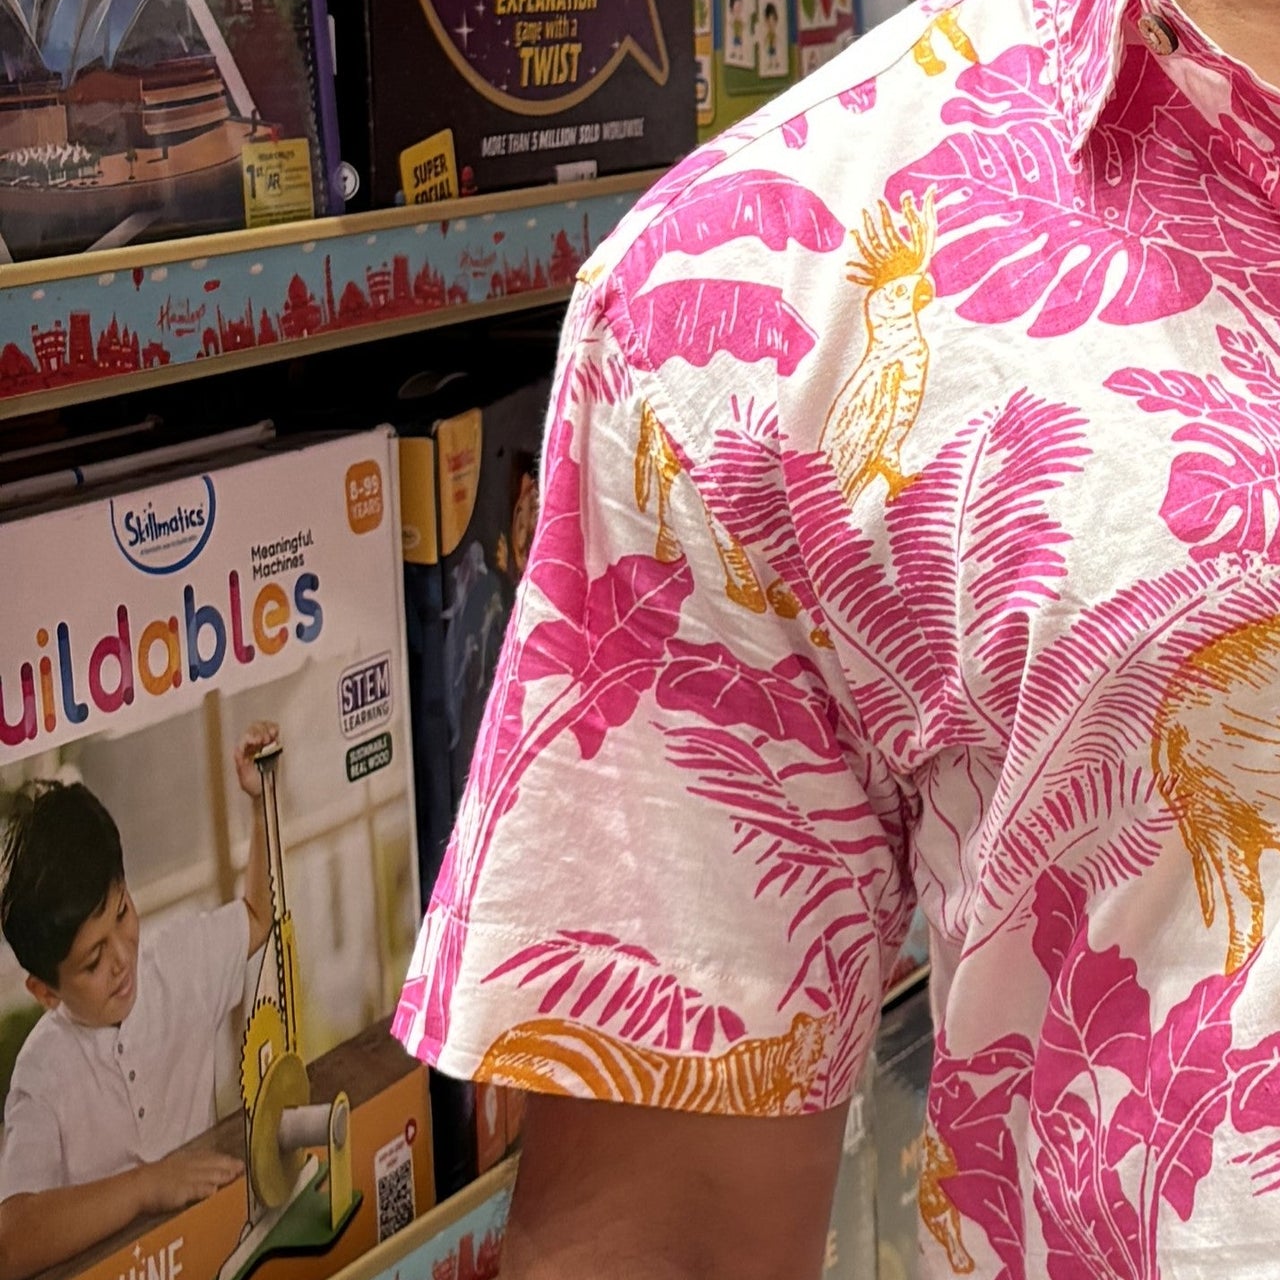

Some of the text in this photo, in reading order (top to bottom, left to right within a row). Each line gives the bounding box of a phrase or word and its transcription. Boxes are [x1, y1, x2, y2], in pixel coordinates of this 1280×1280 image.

[545, 15, 569, 39] with
[519, 42, 582, 88] TWIST
[481, 135, 507, 158] MORE
[508, 132, 530, 153] THAN
[539, 125, 577, 150] MILLION
[413, 152, 448, 189] SUPER
[124, 501, 205, 548] Skillmatics
[351, 497, 382, 521] YEARS
[251, 528, 314, 562] Meaningful
[252, 552, 305, 581] Machines
[343, 661, 390, 713] STEM
[344, 700, 390, 733] LEARNING
